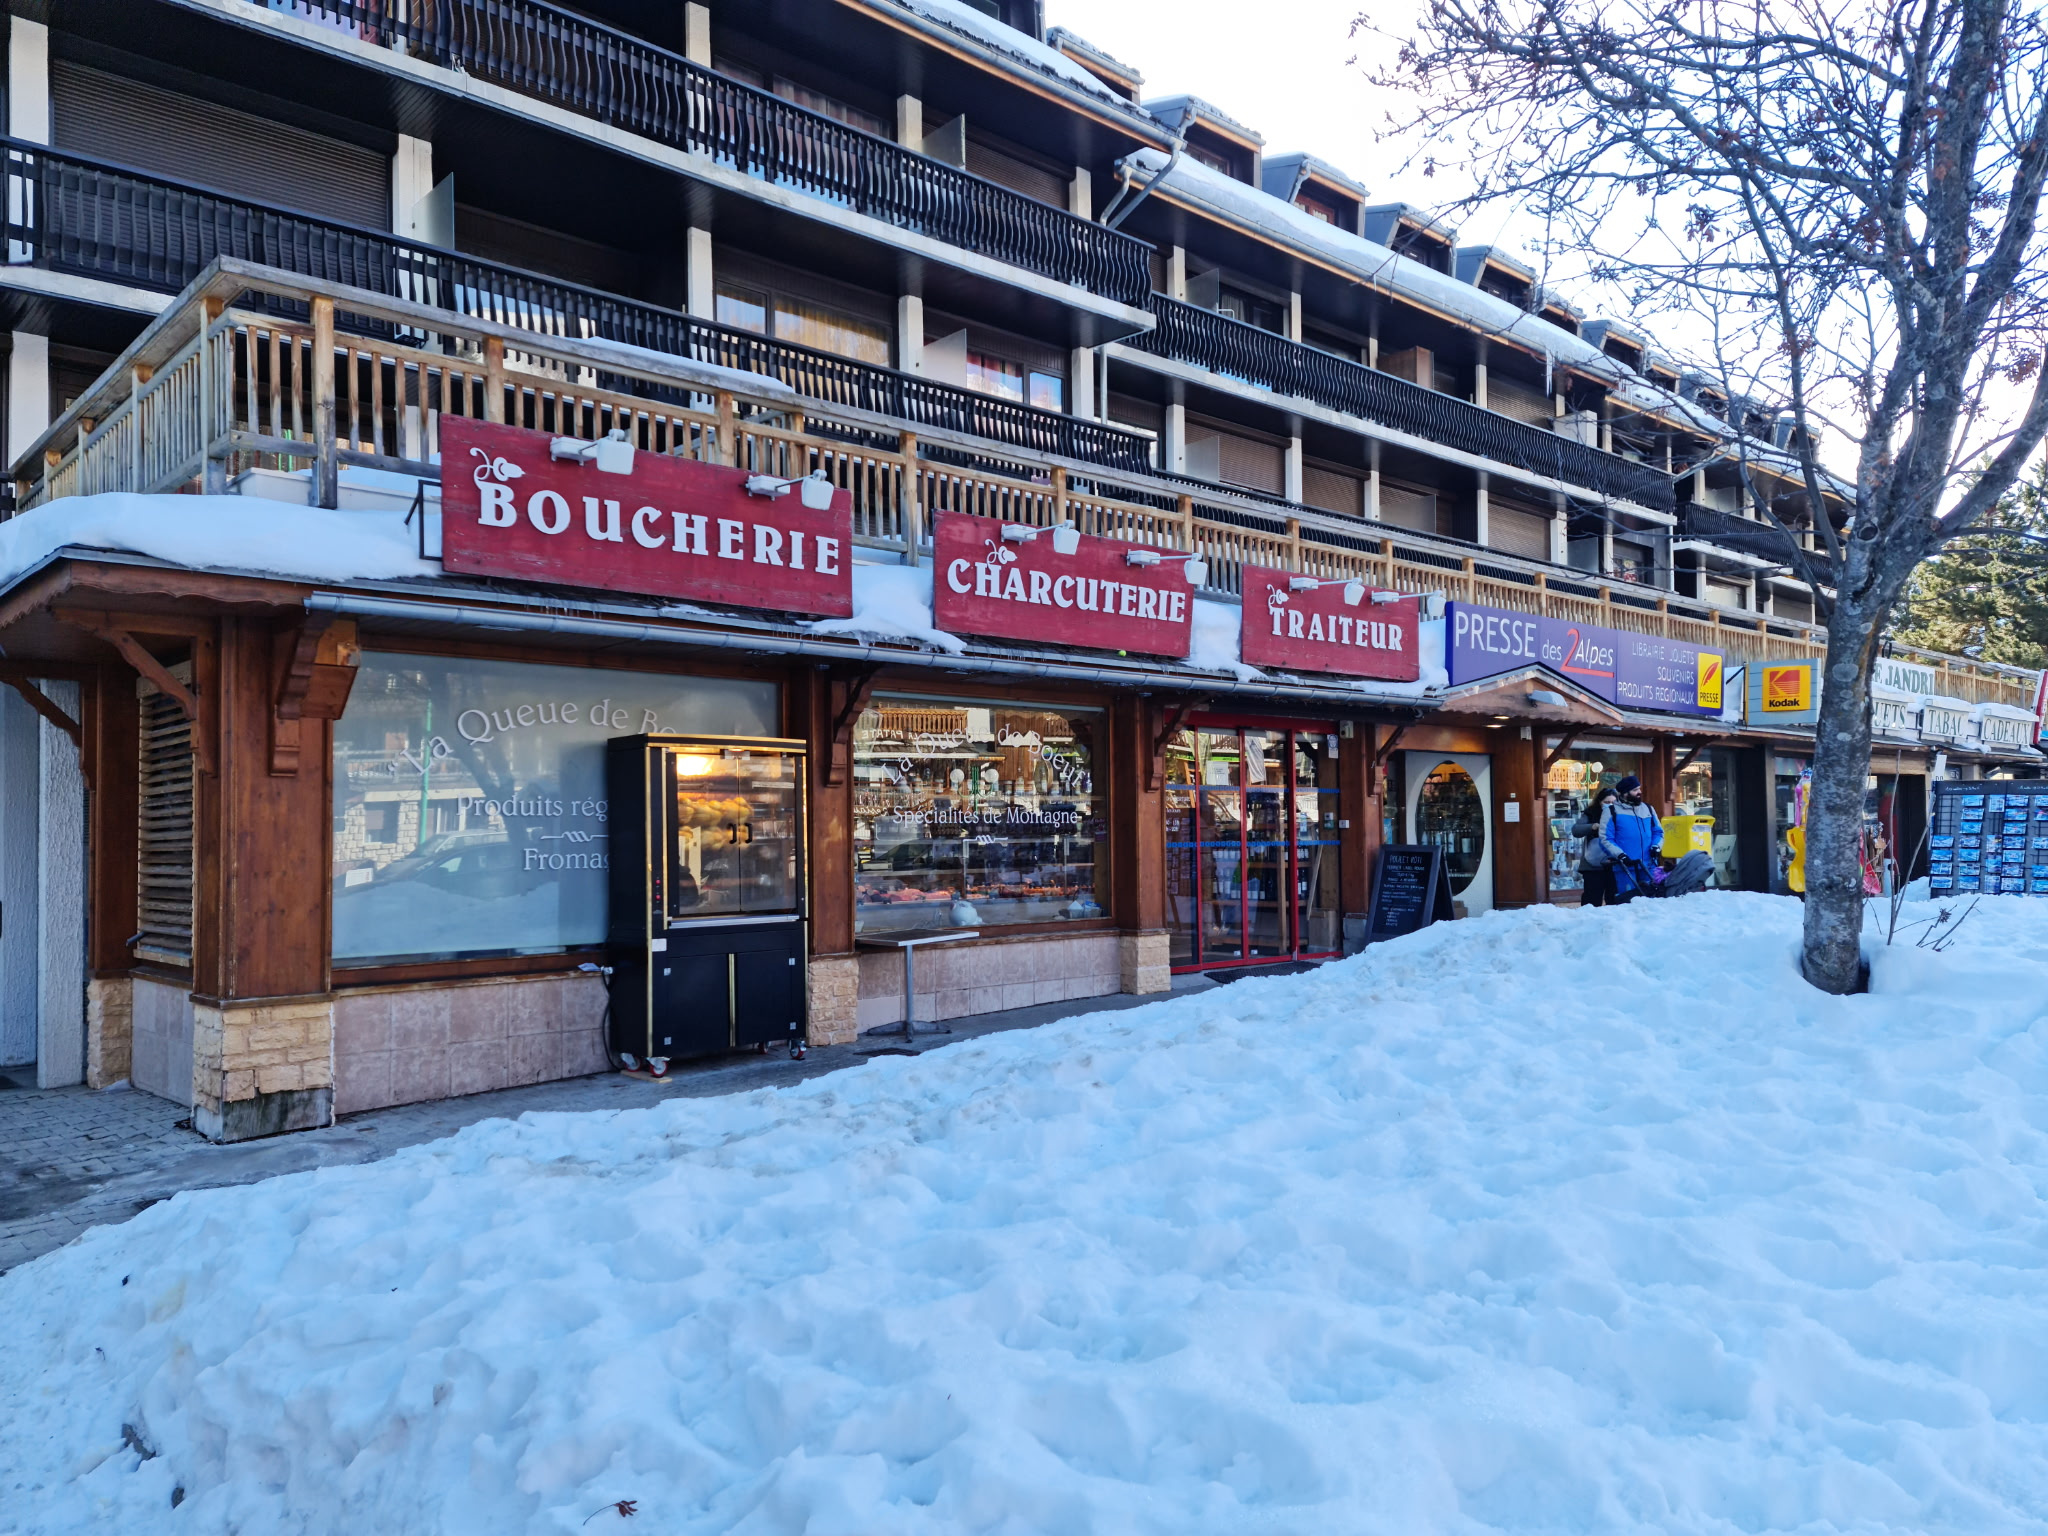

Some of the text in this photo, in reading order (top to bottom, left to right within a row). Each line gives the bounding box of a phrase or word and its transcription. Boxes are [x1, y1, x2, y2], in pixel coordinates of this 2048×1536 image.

[477, 479, 840, 576] BOUCHERIE
[947, 558, 1186, 624] CHARCUTERIE
[1270, 606, 1404, 653] TRAITEUR
[1455, 610, 1537, 658] PRESSE
[1542, 640, 1562, 661] des
[1632, 641, 1665, 660] LIBRAIRIE
[1657, 666, 1695, 685] SOUVENIRS
[1885, 665, 1934, 696] JANDRI
[1617, 681, 1695, 705] PRODUITS REGIONAUX
[1700, 691, 1719, 704] PRESSE
[1768, 697, 1800, 708] Kodak
[457, 700, 579, 746] Queue
[589, 698, 629, 730] de
[1873, 701, 1906, 730] UETS
[1929, 709, 1965, 737] TABAC
[1983, 718, 2030, 746] CADEAUX
[880, 722, 1086, 788] La Queue de Boeuf
[456, 792, 609, 822] Produits rég
[893, 805, 1079, 829] Spécialités de Montagne
[523, 848, 610, 872] Froma
